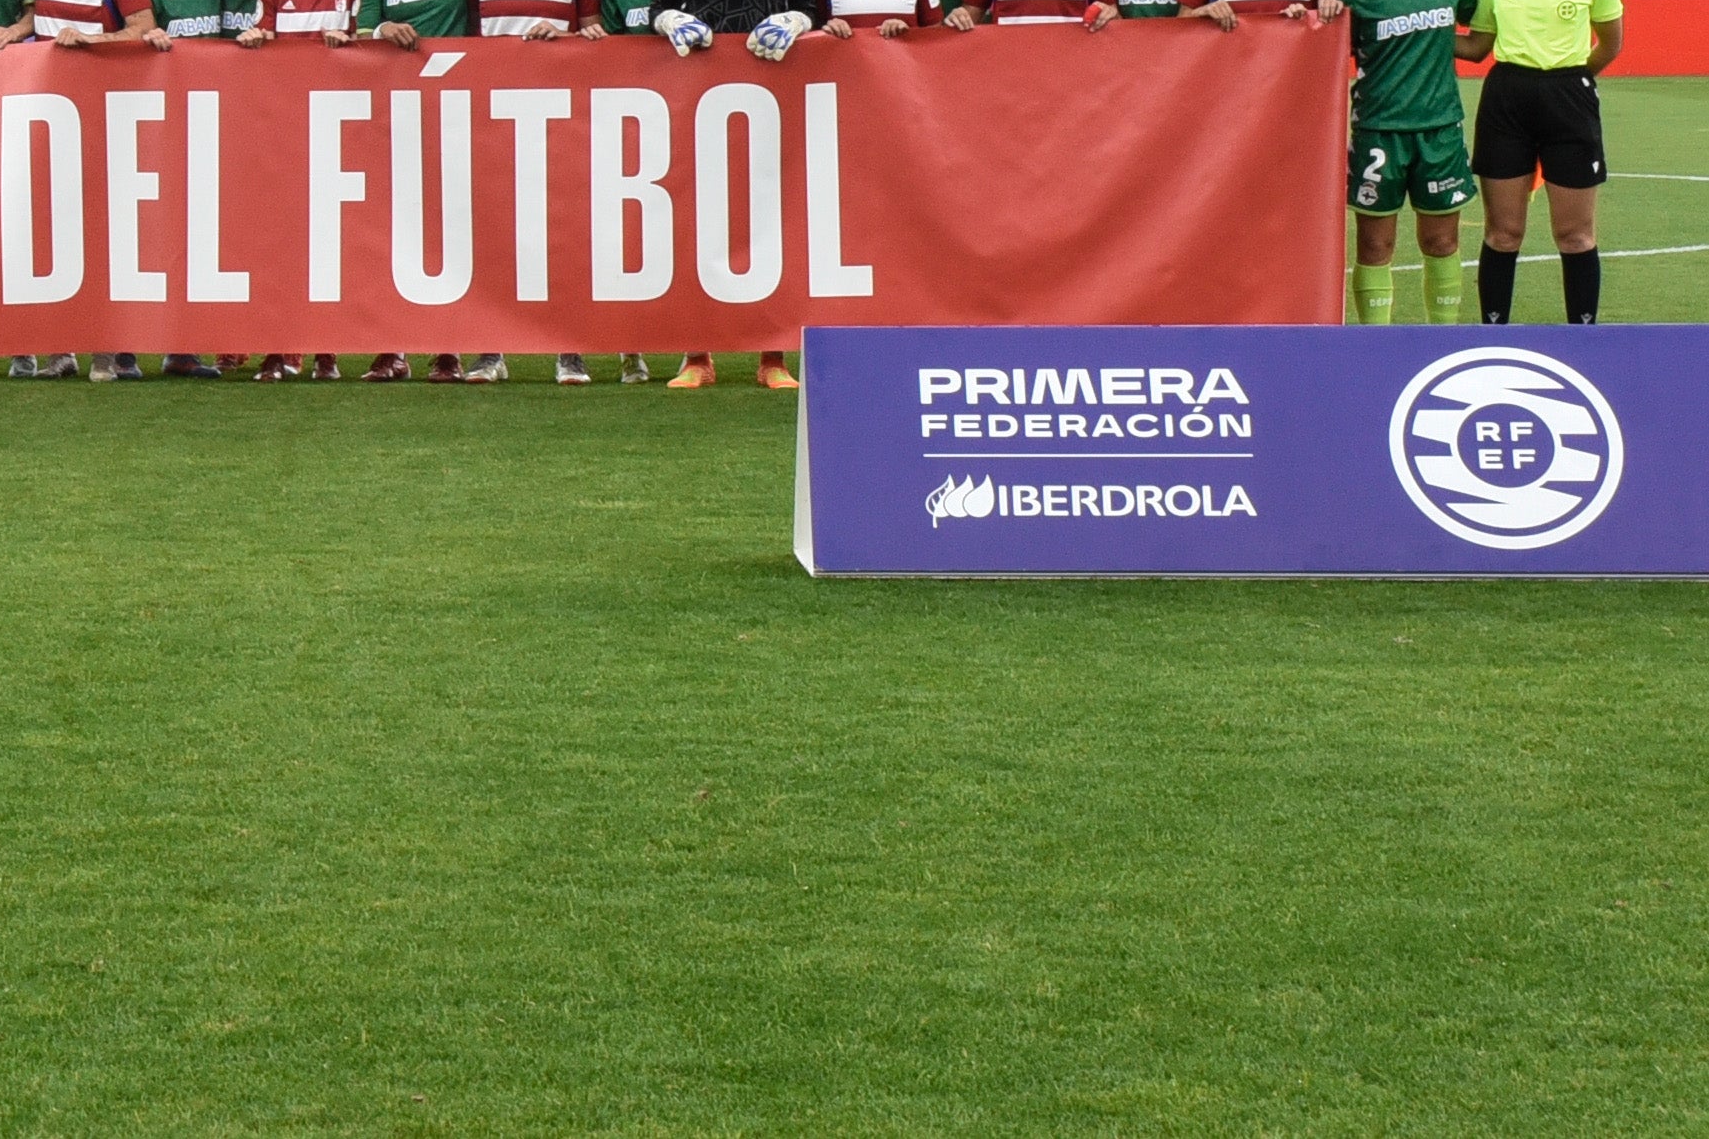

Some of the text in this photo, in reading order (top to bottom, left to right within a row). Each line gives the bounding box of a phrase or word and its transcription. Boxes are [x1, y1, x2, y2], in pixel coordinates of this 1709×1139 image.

[0, 90, 250, 305] DEL
[308, 51, 874, 305] FÚTBOL
[1363, 147, 1386, 183] 2
[918, 368, 1249, 405] PRIMERA
[921, 406, 1252, 438] FEDERACIÓN
[998, 484, 1257, 517] IBERDROLA
